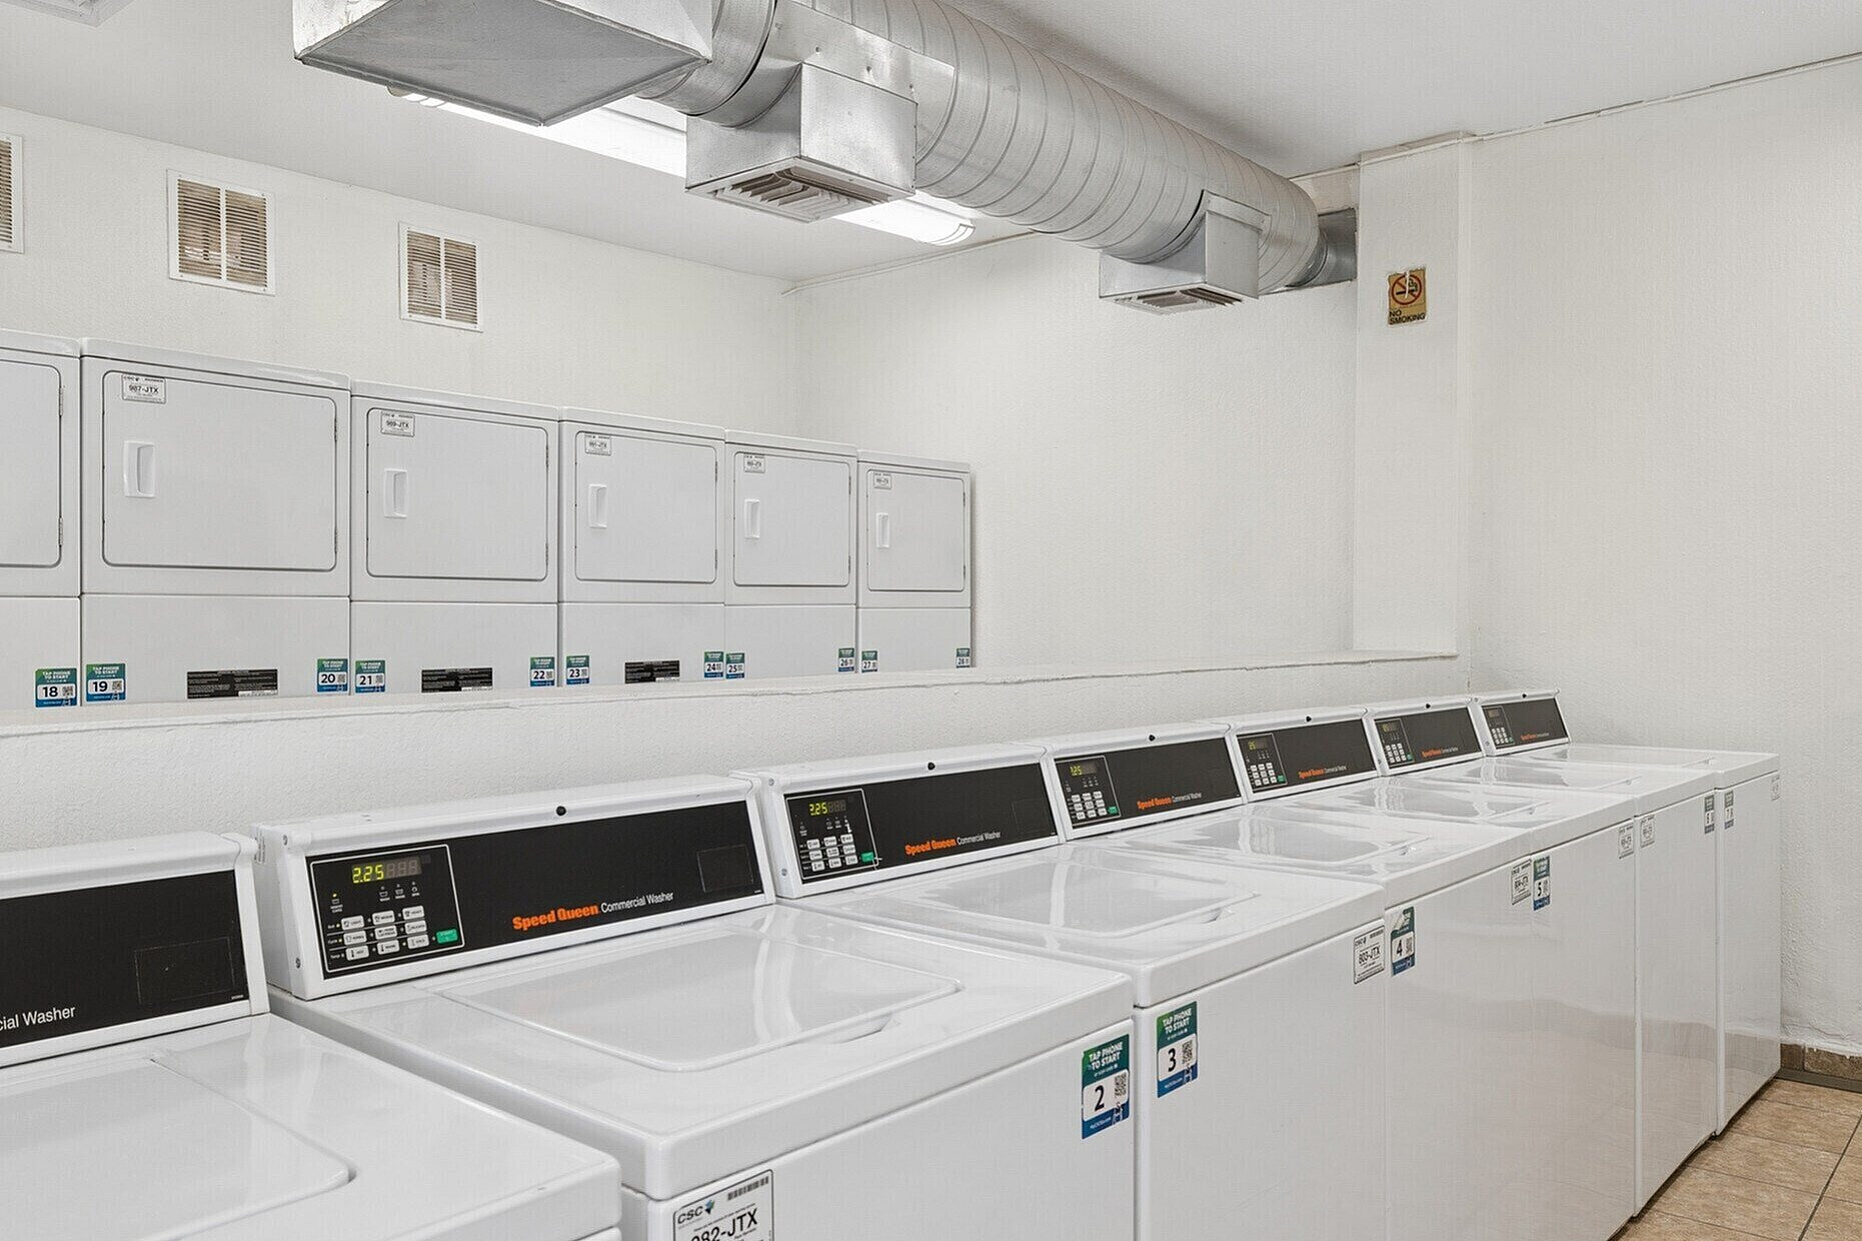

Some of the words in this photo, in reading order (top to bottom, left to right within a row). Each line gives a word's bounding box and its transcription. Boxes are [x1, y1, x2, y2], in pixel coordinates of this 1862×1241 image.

[1389, 309, 1402, 317] NO
[1389, 313, 1425, 325] SMOKING
[706, 664, 716, 672] 24
[728, 665, 738, 673] 25
[863, 661, 871, 669] 27
[321, 673, 336, 684] 20
[359, 675, 372, 685] 21
[533, 670, 545, 680] 22
[569, 669, 580, 678] 23
[42, 686, 58, 698] 18
[92, 681, 108, 692] 19
[904, 841, 931, 856] Speed
[931, 838, 957, 849] Queen
[957, 834, 984, 846] Commercial
[984, 831, 1001, 841] Washer
[352, 863, 384, 884] 2.25
[1537, 881, 1542, 897] 5
[512, 910, 556, 931] Speed
[557, 903, 599, 921] Queen
[600, 896, 646, 914] Commercial
[646, 891, 674, 905] Washer
[1396, 939, 1403, 957] 4
[22, 1006, 76, 1026] Washer
[1162, 1016, 1173, 1027] TAP
[1173, 1007, 1193, 1023] PHONE
[1164, 1025, 1173, 1034] TO
[1173, 1017, 1190, 1032] START
[1089, 1051, 1101, 1062] TAP
[1102, 1042, 1123, 1057] PHONE
[1168, 1047, 1176, 1072] 3
[1091, 1061, 1100, 1071] TO
[1101, 1052, 1120, 1066] START
[1094, 1084, 1105, 1112] 2
[677, 1206, 703, 1224] CSC
